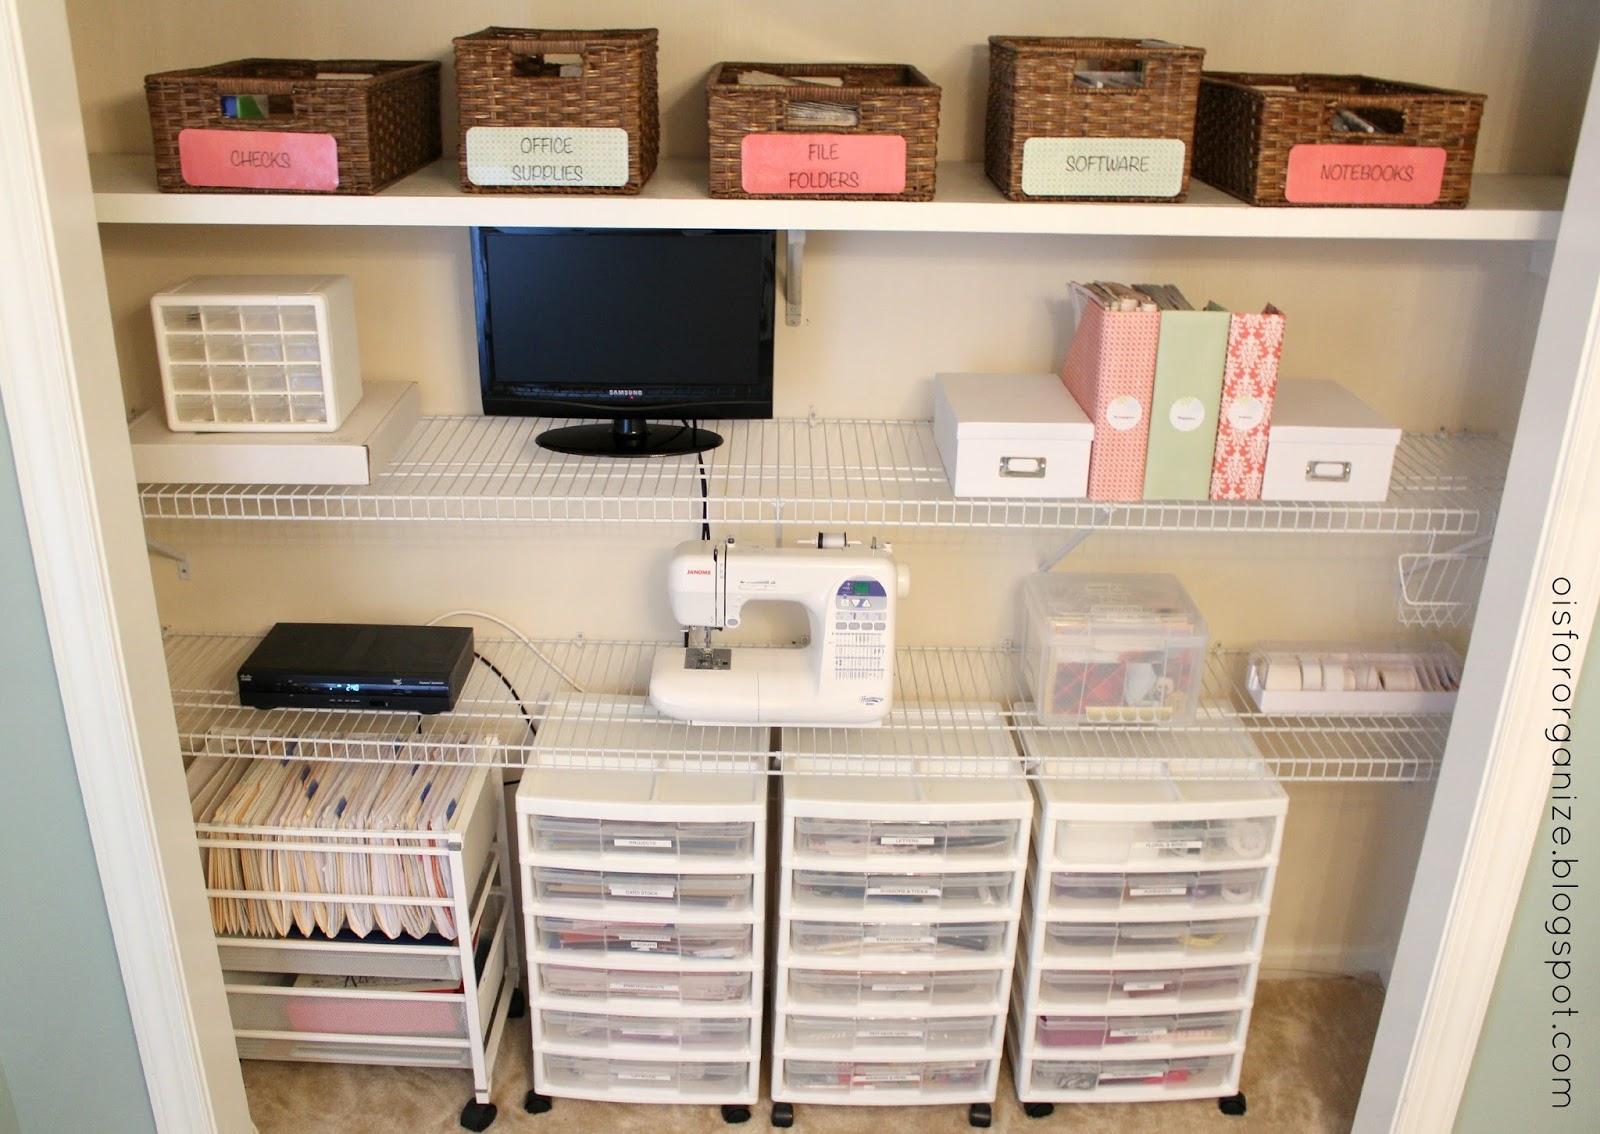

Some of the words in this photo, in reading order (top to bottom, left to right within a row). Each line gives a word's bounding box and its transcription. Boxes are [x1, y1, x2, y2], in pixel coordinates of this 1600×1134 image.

[520, 137, 574, 154] OFFICE
[808, 143, 840, 160] FILE
[230, 149, 291, 169] CHECKS
[1065, 155, 1151, 173] SOFTWARE
[512, 164, 584, 182] SUPPLIES
[789, 171, 860, 189] FOLDERS
[1320, 163, 1415, 182] NOTEBOOKS
